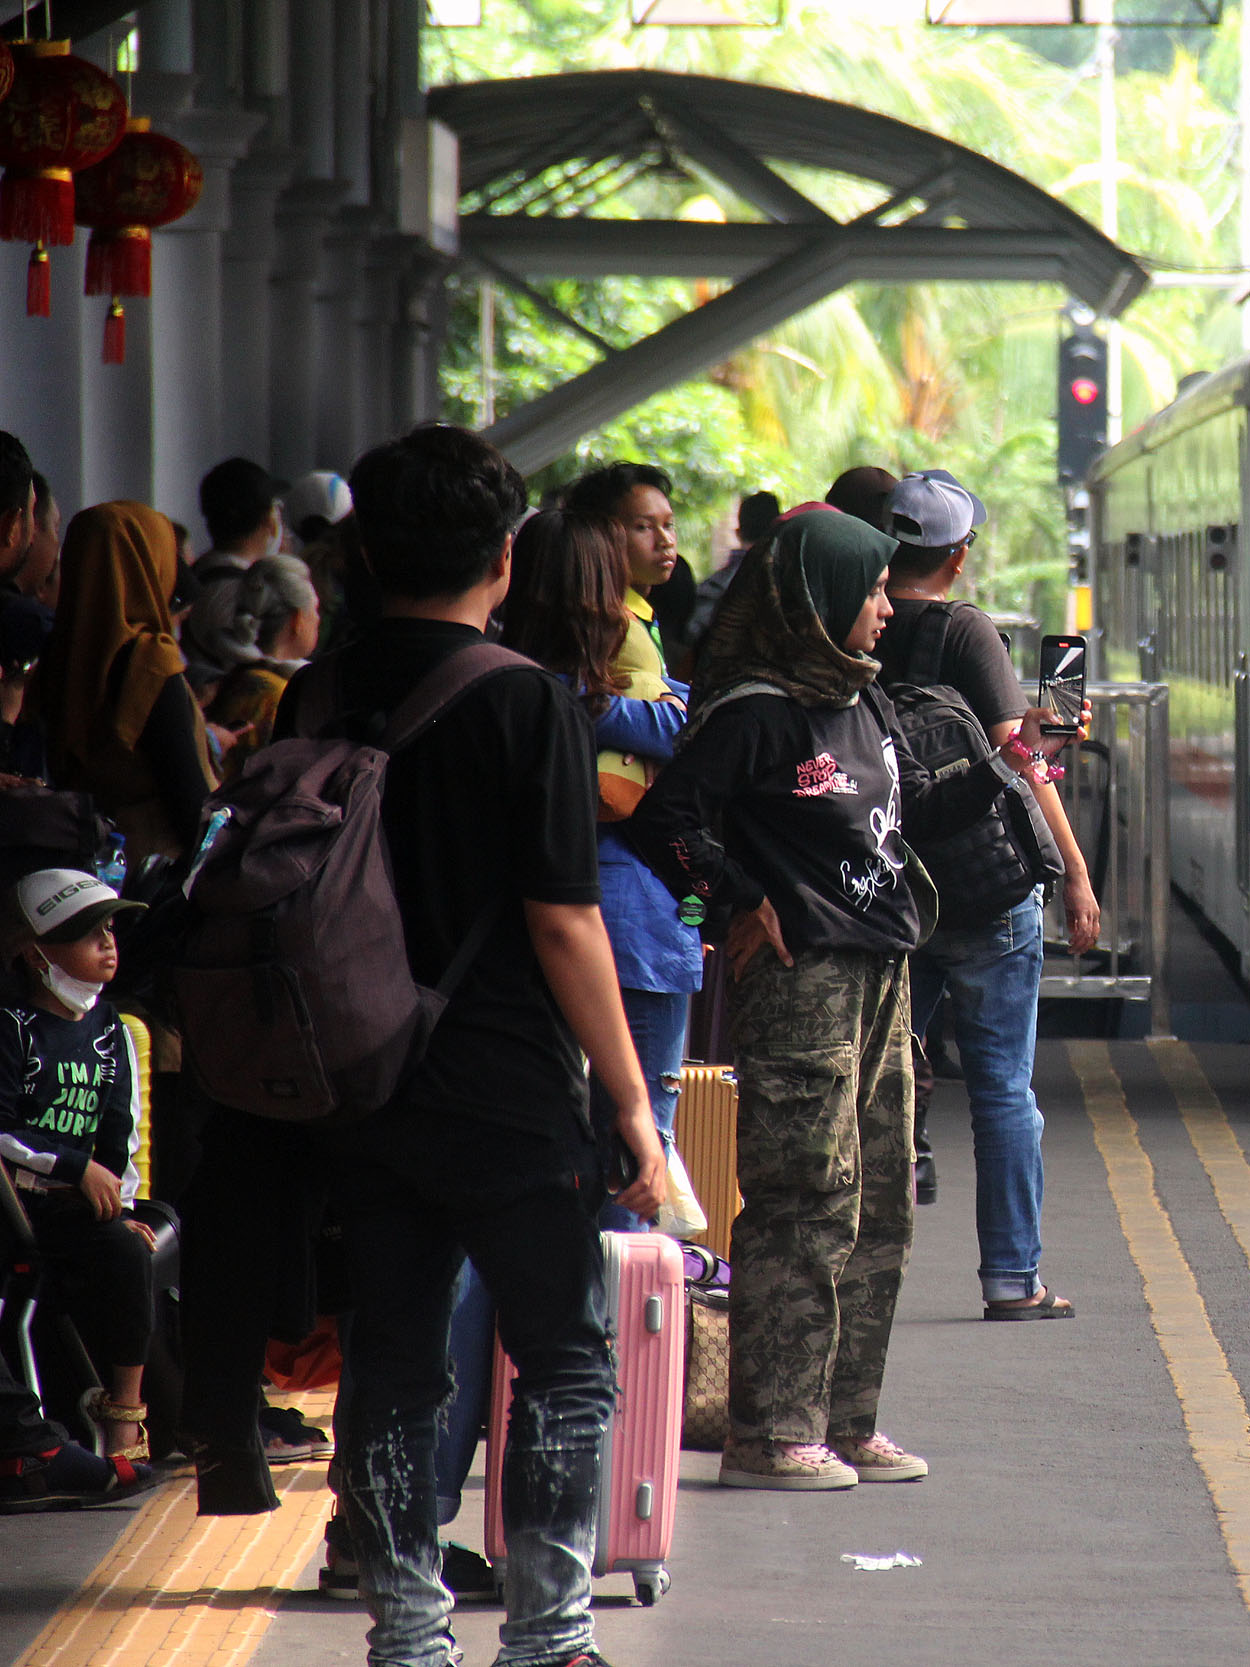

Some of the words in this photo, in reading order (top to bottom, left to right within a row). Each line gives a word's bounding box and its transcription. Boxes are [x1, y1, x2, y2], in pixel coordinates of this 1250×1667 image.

[796, 752, 836, 775] NEVER
[797, 763, 837, 787] STOP
[57, 1061, 89, 1085] I'M
